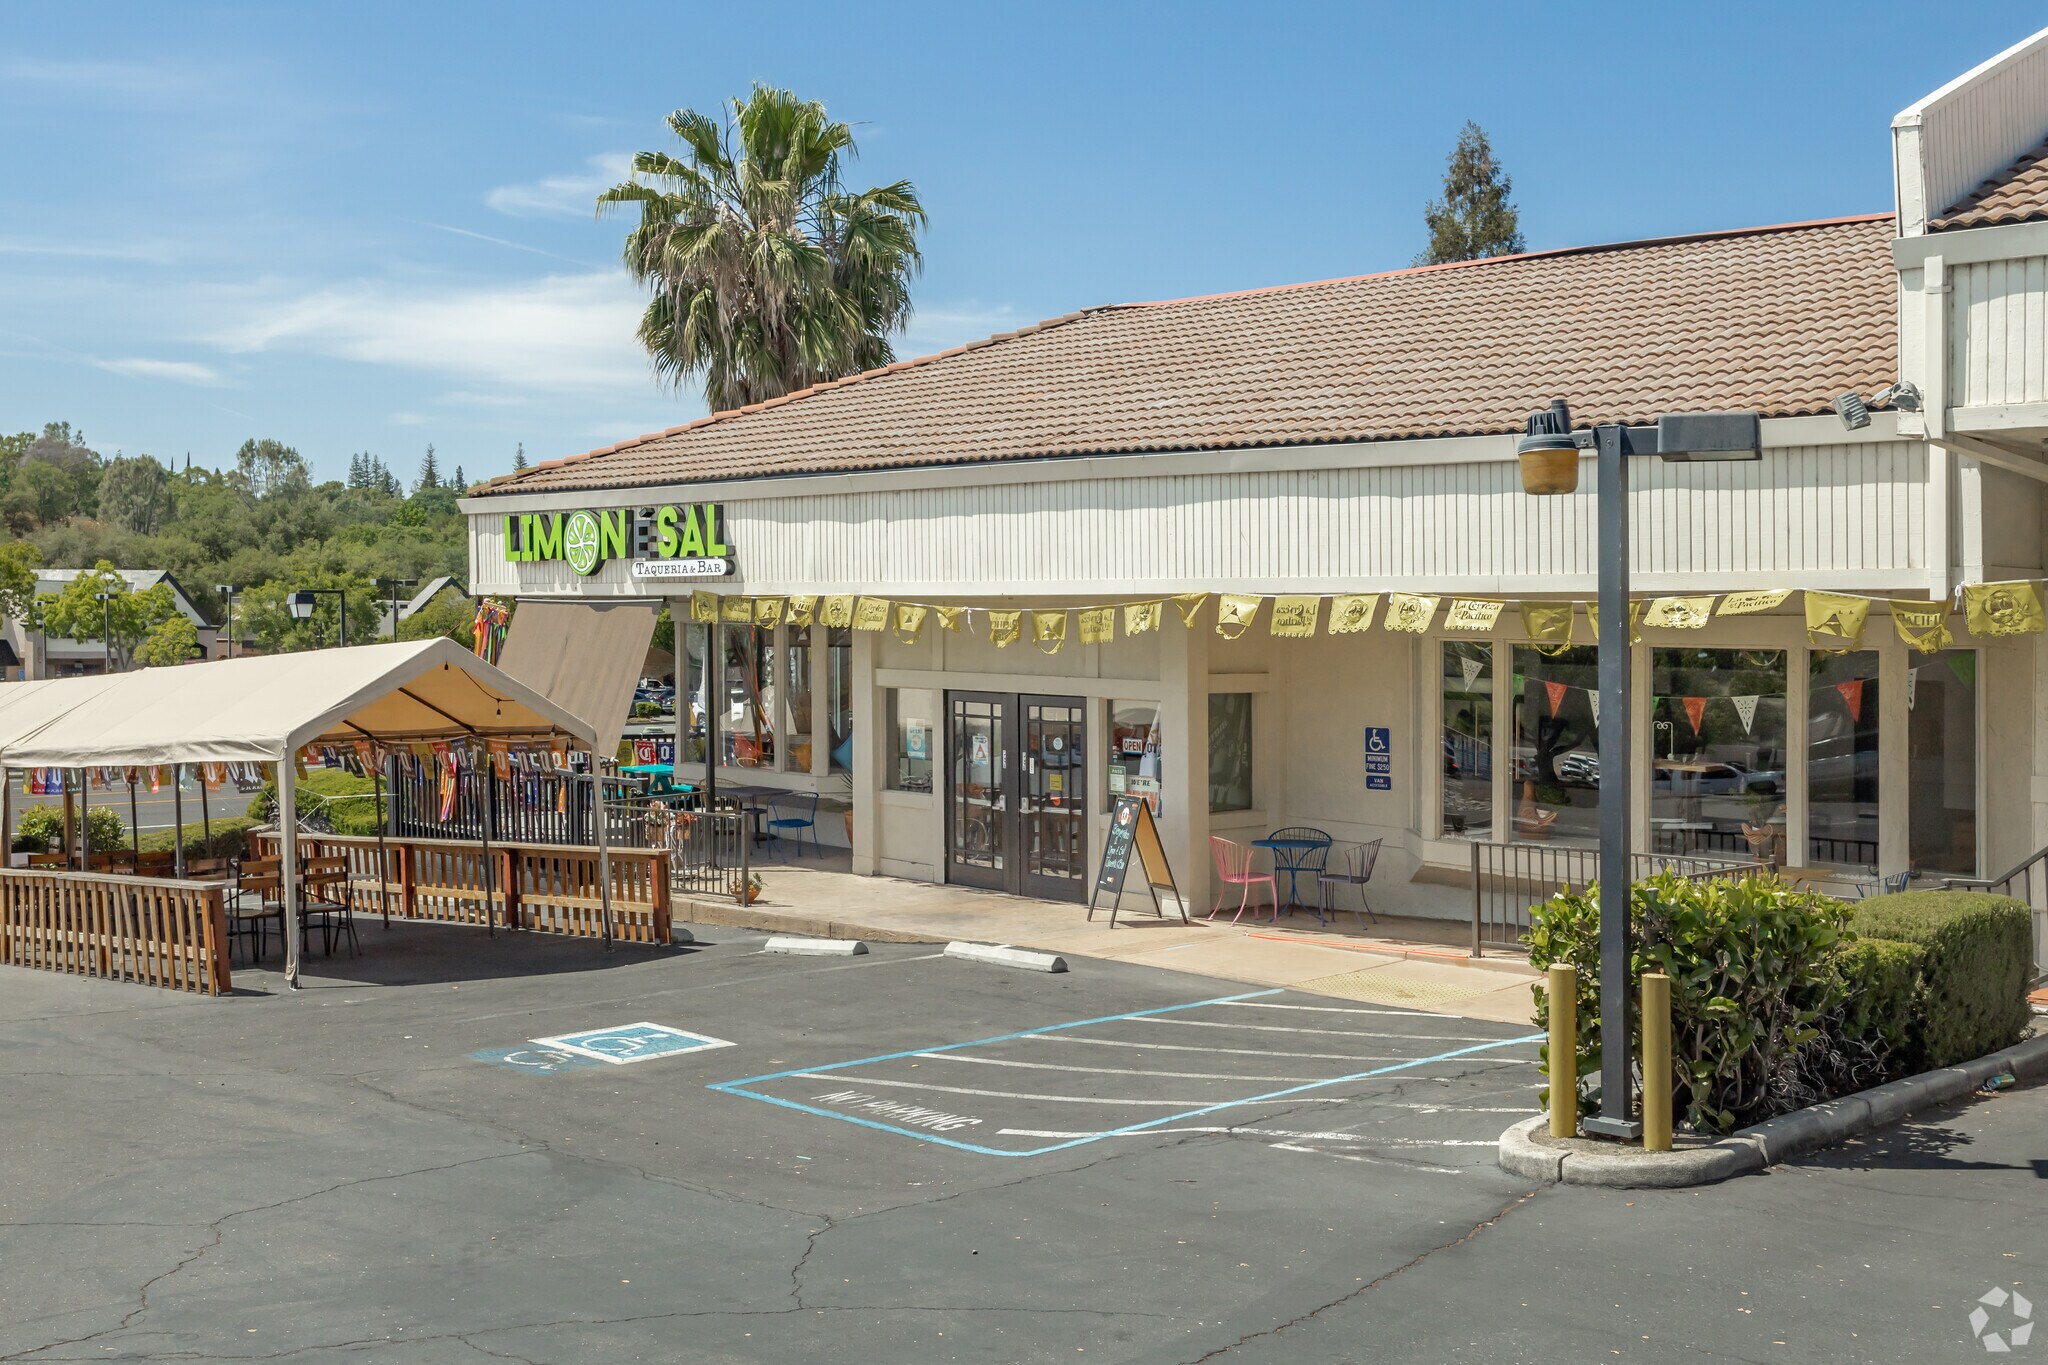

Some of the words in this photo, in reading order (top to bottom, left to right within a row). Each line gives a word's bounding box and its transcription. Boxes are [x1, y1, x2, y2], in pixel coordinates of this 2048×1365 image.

[657, 504, 728, 558] SAL
[636, 562, 688, 576] TAQUERIA
[690, 566, 696, 574] &
[697, 560, 721, 573] BAR
[1468, 601, 1500, 611] Cerveza
[1124, 741, 1141, 751] OPEN
[1377, 763, 1390, 771] $250
[811, 1090, 876, 1105] NO
[848, 1100, 983, 1132] PARKING
